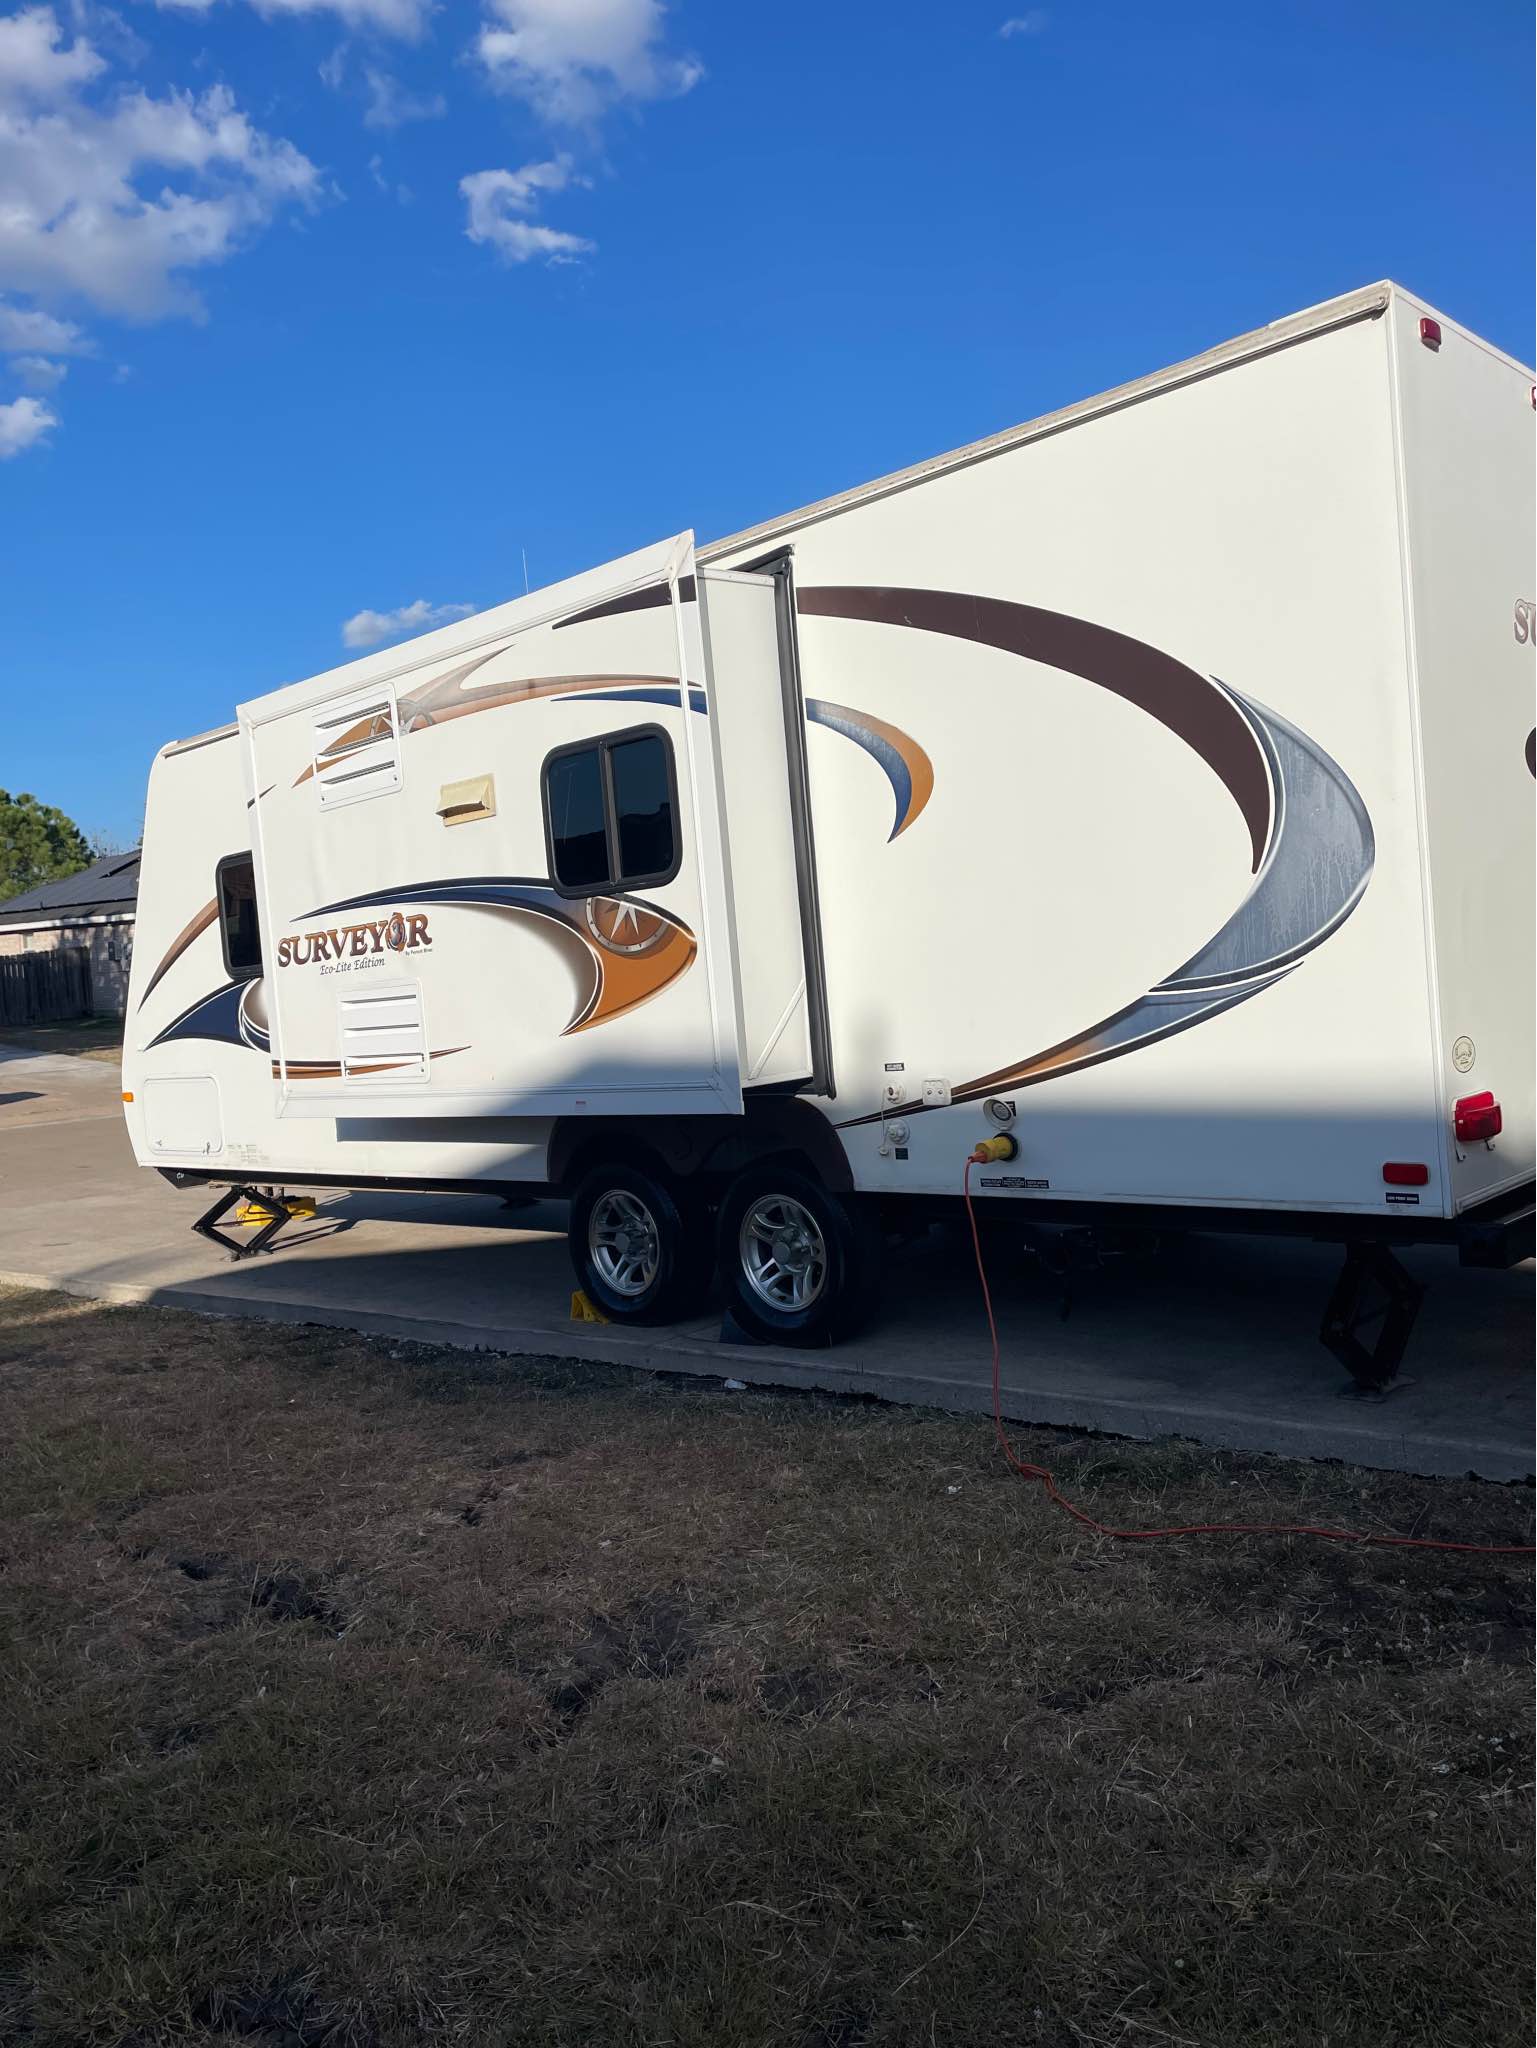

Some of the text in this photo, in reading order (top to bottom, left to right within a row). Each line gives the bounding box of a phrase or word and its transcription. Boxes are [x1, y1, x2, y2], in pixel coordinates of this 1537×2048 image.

[277, 912, 432, 967] SURVEYOR
[320, 956, 385, 975] Eco-Lite Edition
